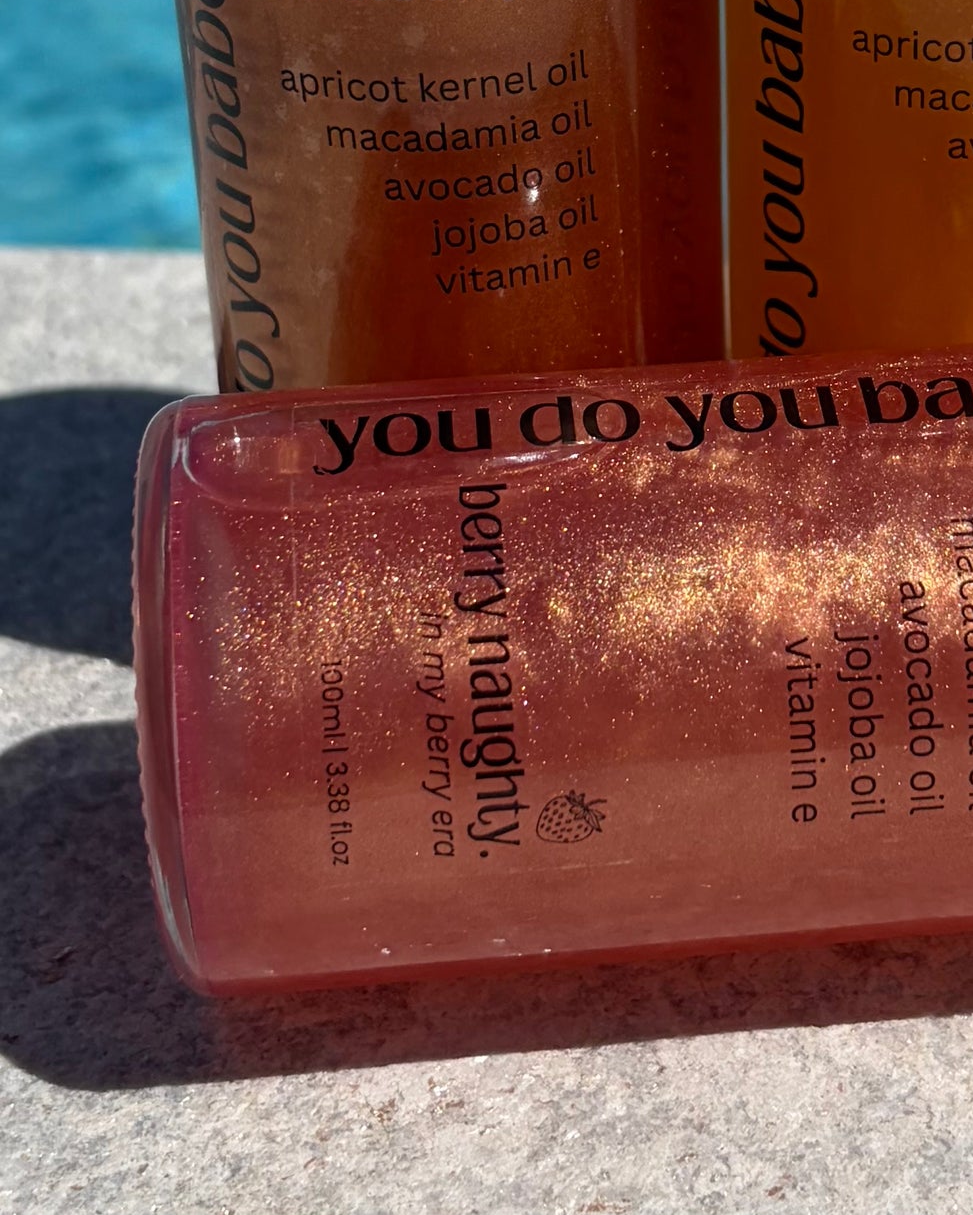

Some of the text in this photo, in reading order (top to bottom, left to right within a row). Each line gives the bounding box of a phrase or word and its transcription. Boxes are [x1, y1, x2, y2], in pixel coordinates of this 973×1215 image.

[280, 50, 589, 103] apricot kernel oil
[326, 100, 593, 153] macadamia oil
[384, 147, 596, 201] avocado oil
[212, 178, 280, 338] you
[431, 195, 598, 255] jojoba oil
[761, 140, 818, 298] you
[436, 248, 601, 295] vitamin e
[234, 339, 275, 392] o
[759, 297, 806, 357] o
[314, 407, 493, 475] you
[519, 395, 641, 446] do
[666, 384, 841, 451] you
[321, 660, 346, 739] 100ml
[454, 483, 529, 859] berry naughty.
[900, 581, 944, 815] avocado oil
[416, 612, 455, 857] in my berry era
[785, 637, 826, 824] vitamin e
[834, 632, 885, 820] jojoba oil
[326, 761, 351, 814] 3.38
